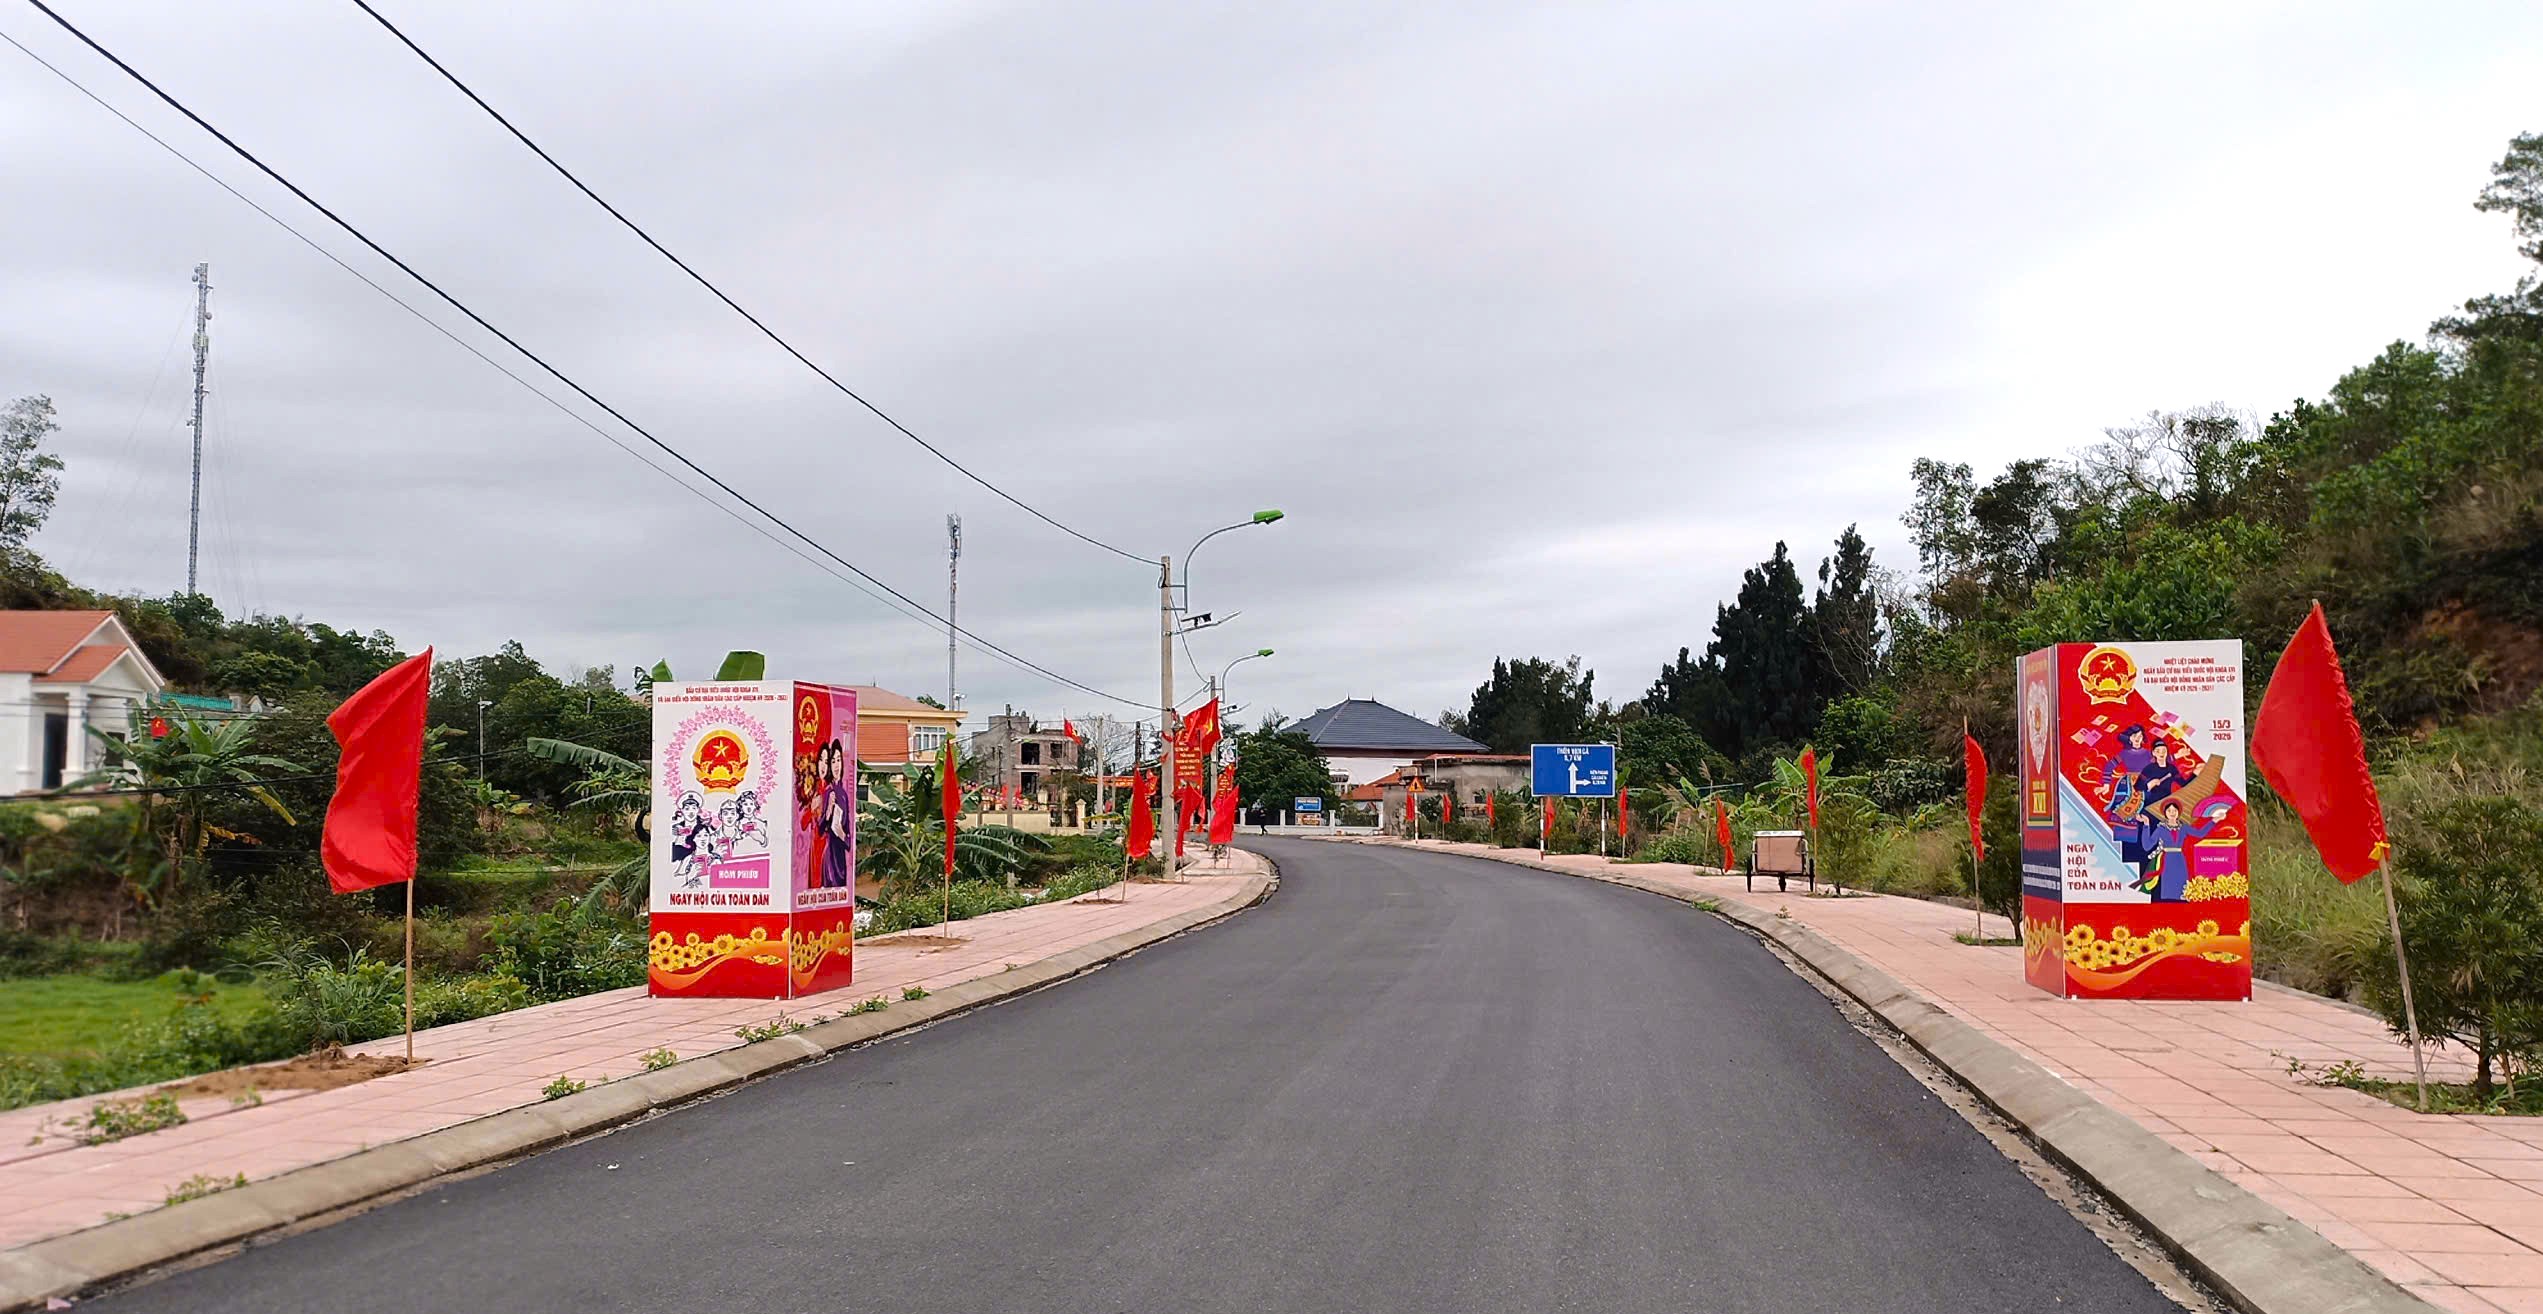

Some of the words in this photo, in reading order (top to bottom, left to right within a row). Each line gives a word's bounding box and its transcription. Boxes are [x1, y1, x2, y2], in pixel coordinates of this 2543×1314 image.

[2212, 719, 2231, 729] 15/3
[2066, 843, 2095, 853] NGÀY
[2067, 855, 2087, 867] HỘI
[2067, 867, 2089, 878] CỦA
[2067, 880, 2096, 890] TOÀN
[693, 890, 709, 909] HỘI
[710, 889, 727, 906] CỦA
[728, 891, 750, 906] TOÀN
